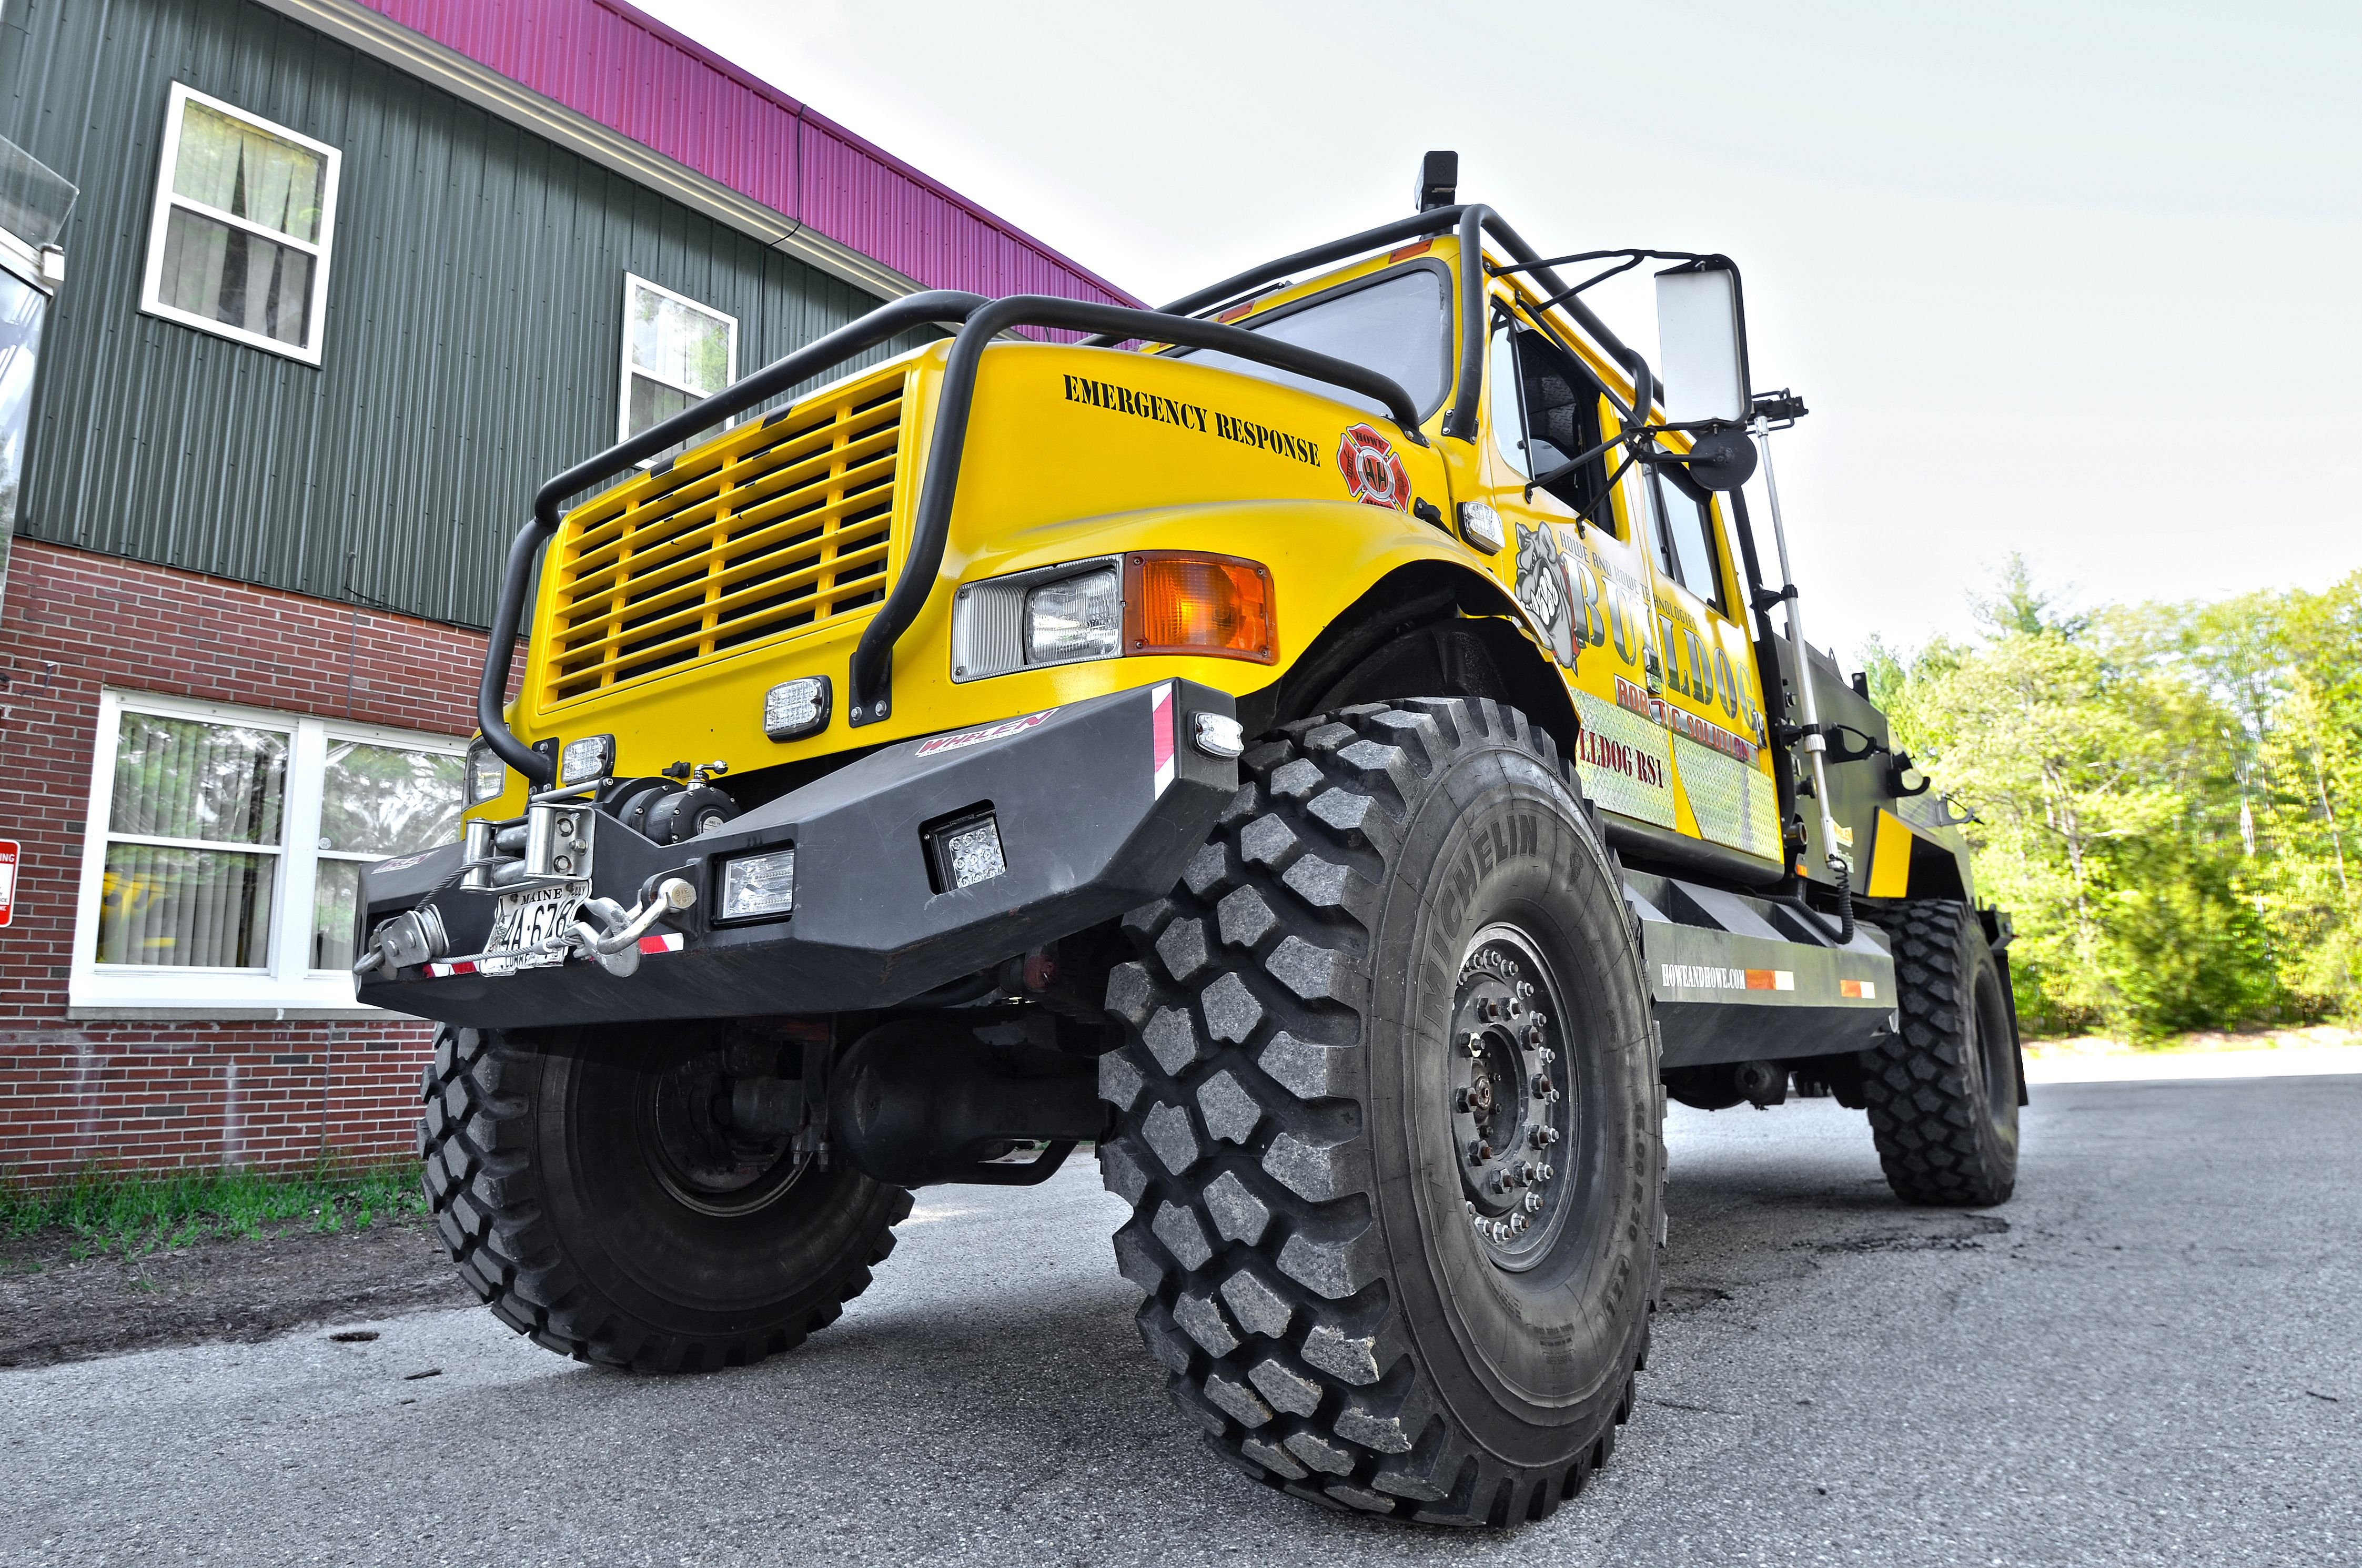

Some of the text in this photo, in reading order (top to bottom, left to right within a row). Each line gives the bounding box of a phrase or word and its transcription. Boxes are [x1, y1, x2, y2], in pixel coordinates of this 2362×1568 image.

[1063, 375, 1321, 468] EMERGENCY RESPONSE
[1355, 431, 1385, 450] HOWE
[1559, 531, 1697, 631] HOWE AND HOWE TEHNOLOGIES
[918, 711, 1054, 754] WHELEN
[1580, 728, 1663, 788] LLDOG RS1
[520, 888, 563, 905] MAINE
[1423, 814, 1538, 1029] MICHELIN
[1661, 963, 1746, 990] HOWEANDHOWE.COM
